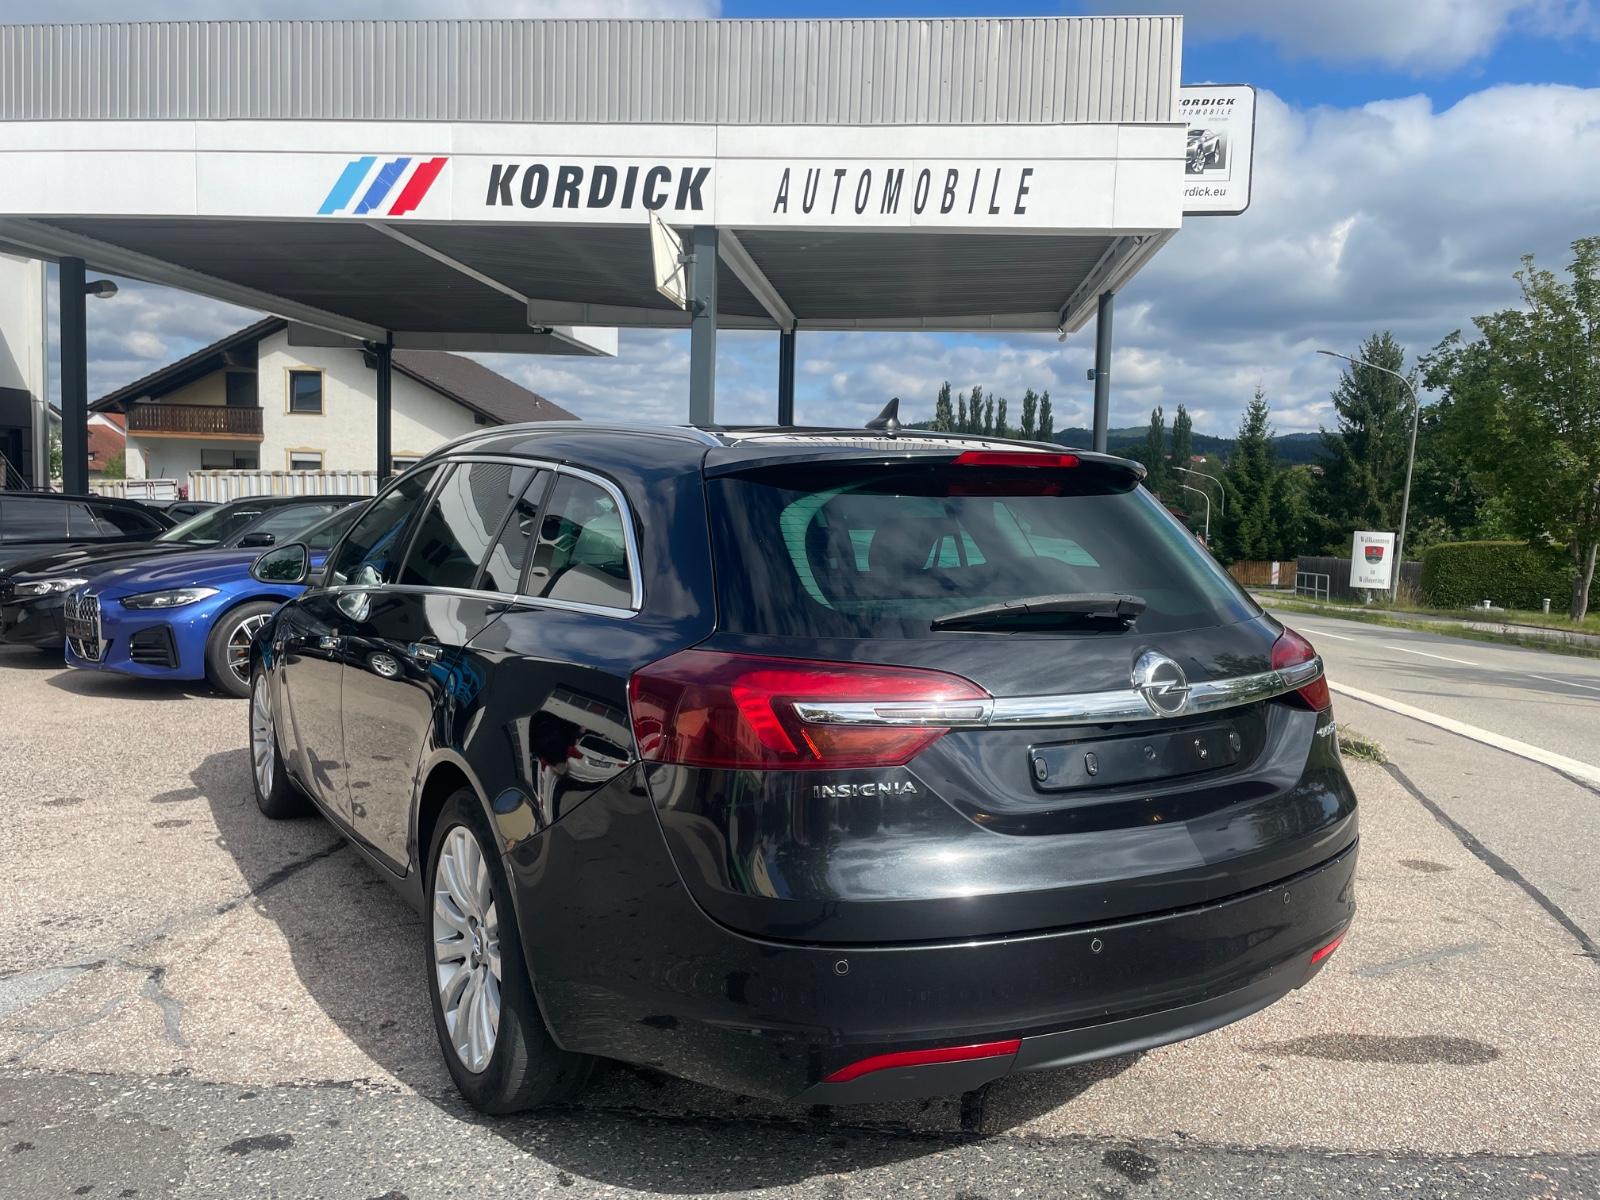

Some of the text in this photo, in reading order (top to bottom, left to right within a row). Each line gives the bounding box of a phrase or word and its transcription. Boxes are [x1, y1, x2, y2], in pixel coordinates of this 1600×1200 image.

[1179, 108, 1232, 116] TOMOBILE
[485, 163, 1034, 215] KORDICK AUTOMOBILE
[813, 781, 918, 798] INSIGNIA
